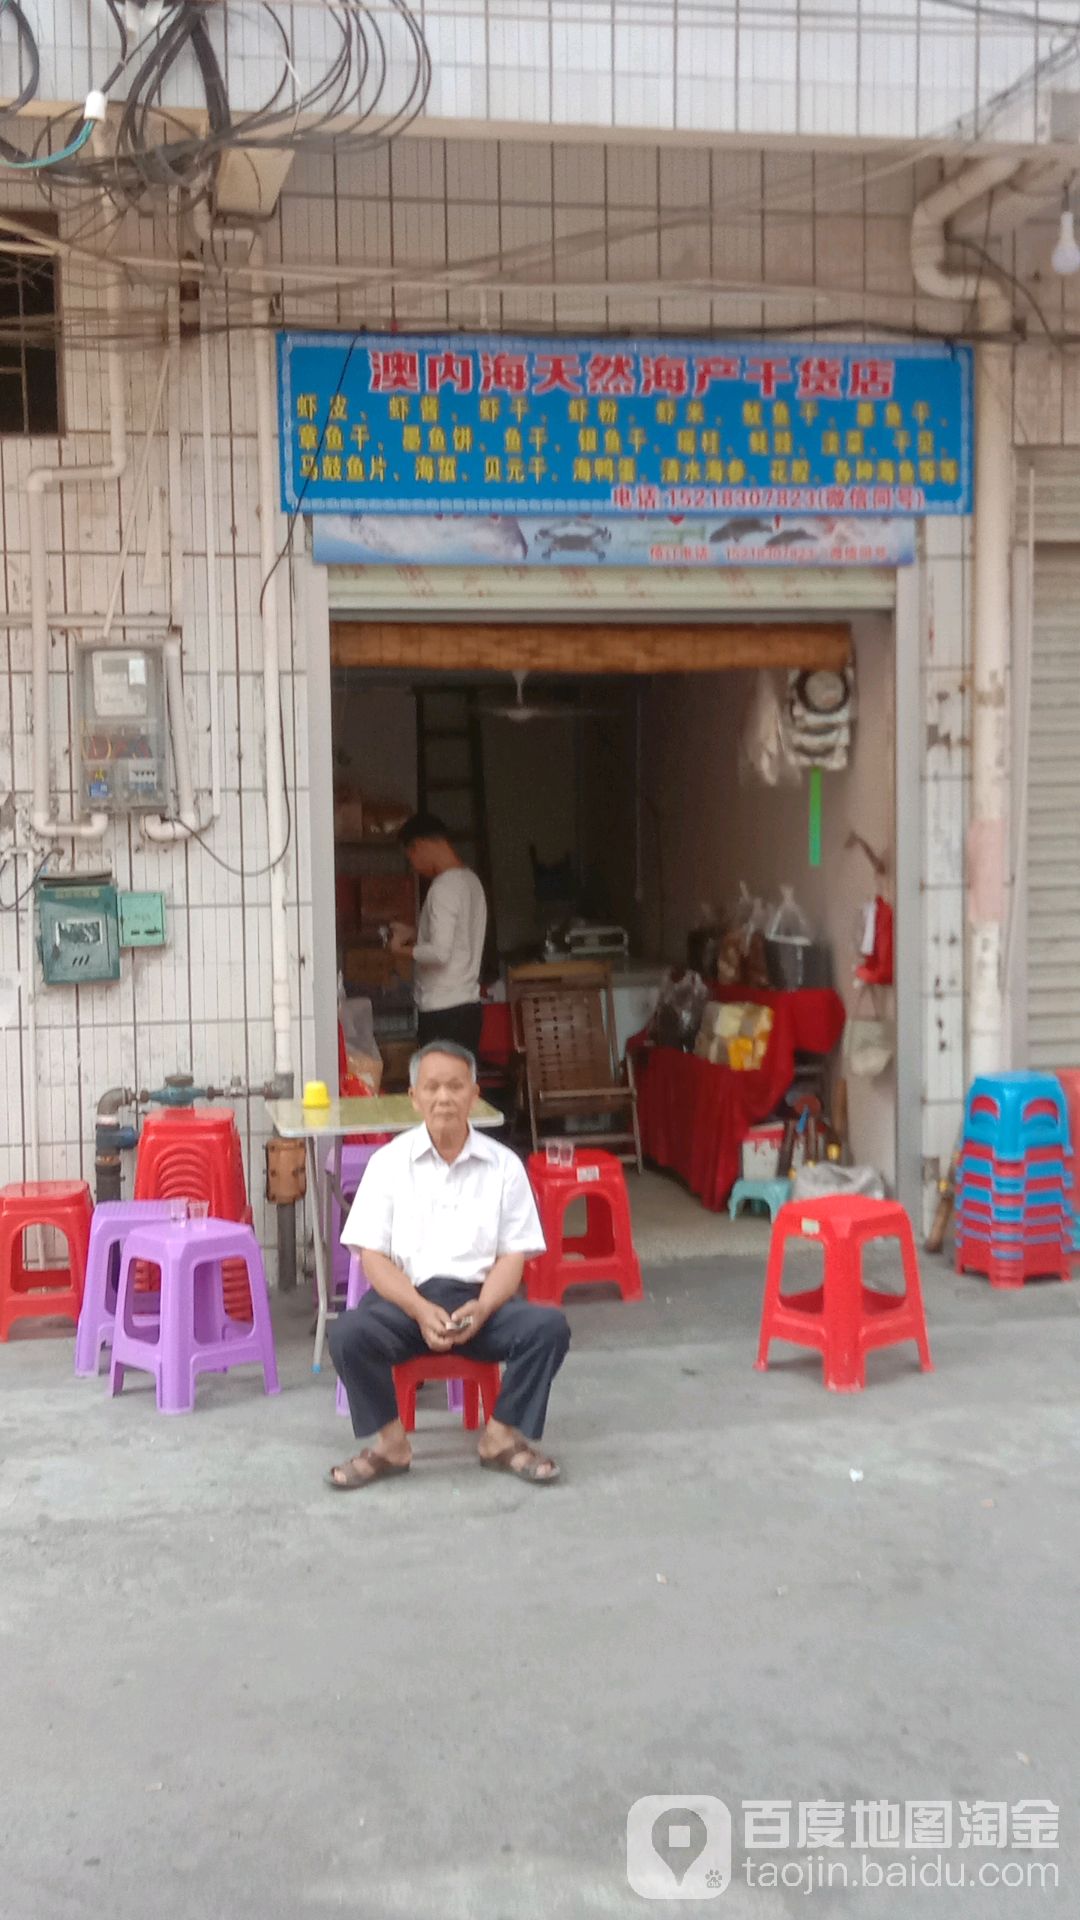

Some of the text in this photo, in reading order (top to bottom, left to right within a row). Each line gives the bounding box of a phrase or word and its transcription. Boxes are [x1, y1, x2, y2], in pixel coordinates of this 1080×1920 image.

[368, 349, 894, 399] 澳内海天然海产干货店
